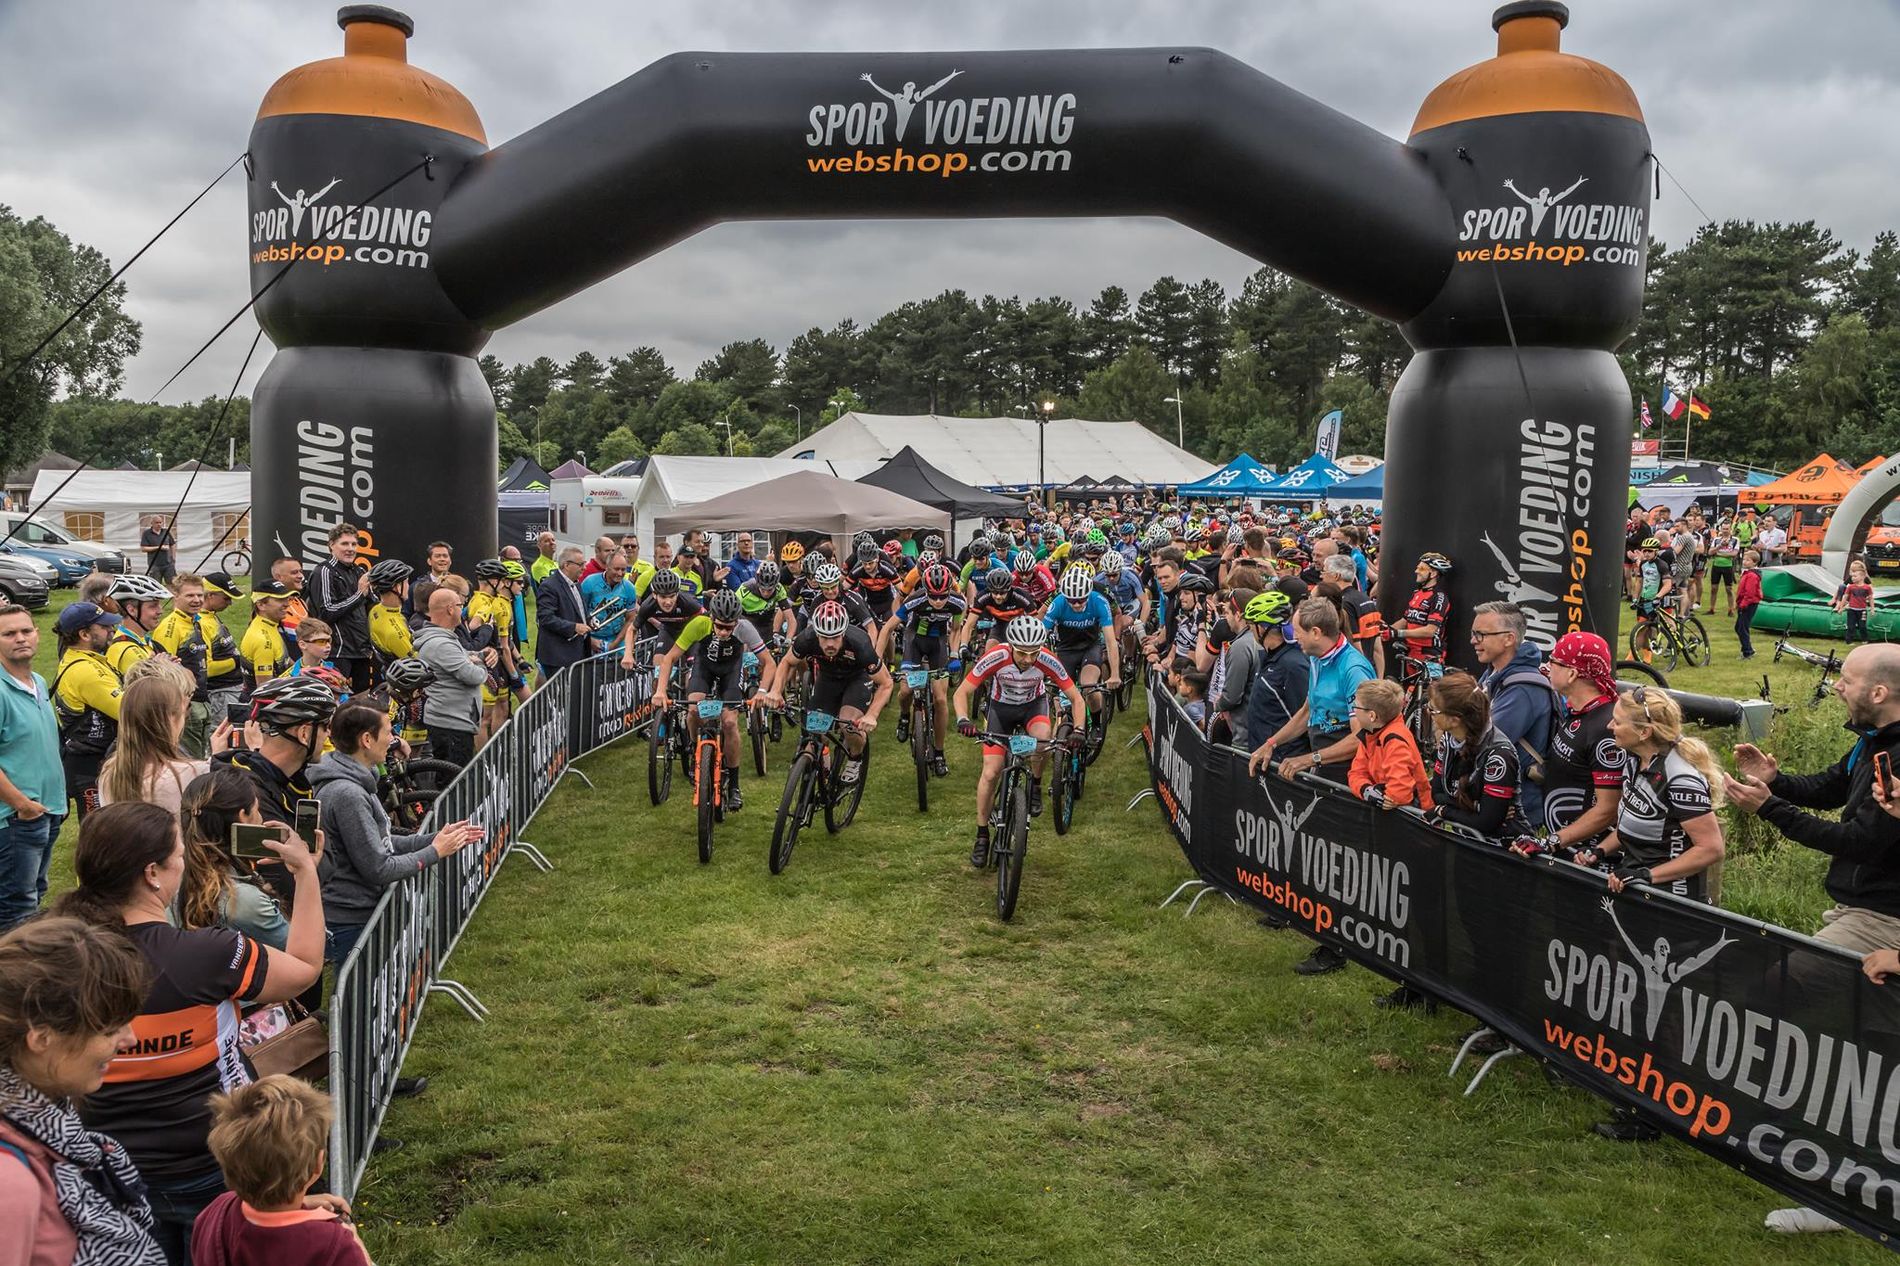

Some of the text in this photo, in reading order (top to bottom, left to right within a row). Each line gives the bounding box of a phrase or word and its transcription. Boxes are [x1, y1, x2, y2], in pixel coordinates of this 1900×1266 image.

[925, 93, 1077, 145] VOEDING
[806, 148, 1072, 177] webshop.com
[311, 205, 432, 247] VOEDING
[1554, 204, 1643, 246] VOEDING
[253, 242, 429, 269] webshop.com
[1456, 241, 1640, 266] webshop.com
[1518, 419, 1572, 573] VOEDING
[1627, 793, 1650, 814] TREND
[1300, 831, 1410, 929] VOEDING
[1236, 866, 1410, 969] webshop.com
[1544, 1017, 1900, 1222] webshop.com
